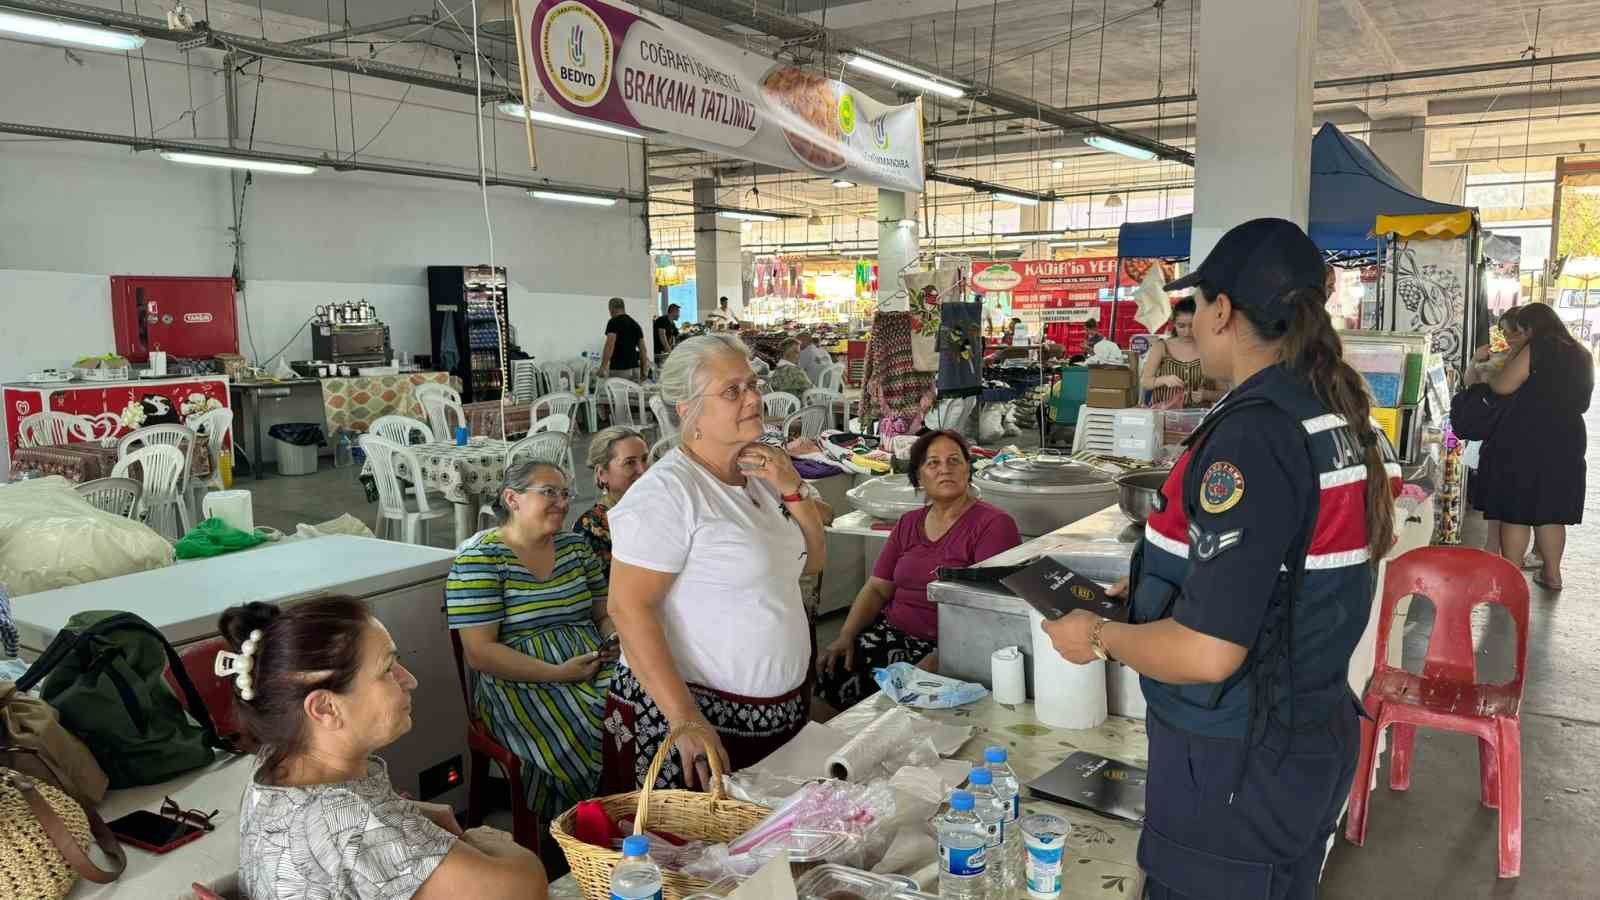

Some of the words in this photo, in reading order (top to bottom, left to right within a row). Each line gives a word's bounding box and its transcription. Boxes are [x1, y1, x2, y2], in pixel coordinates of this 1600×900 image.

[640, 40, 695, 76] COĞRAFİ
[560, 66, 596, 87] BEDYD
[624, 67, 696, 116] BRAKANA
[700, 88, 756, 131] TATLIMIZ
